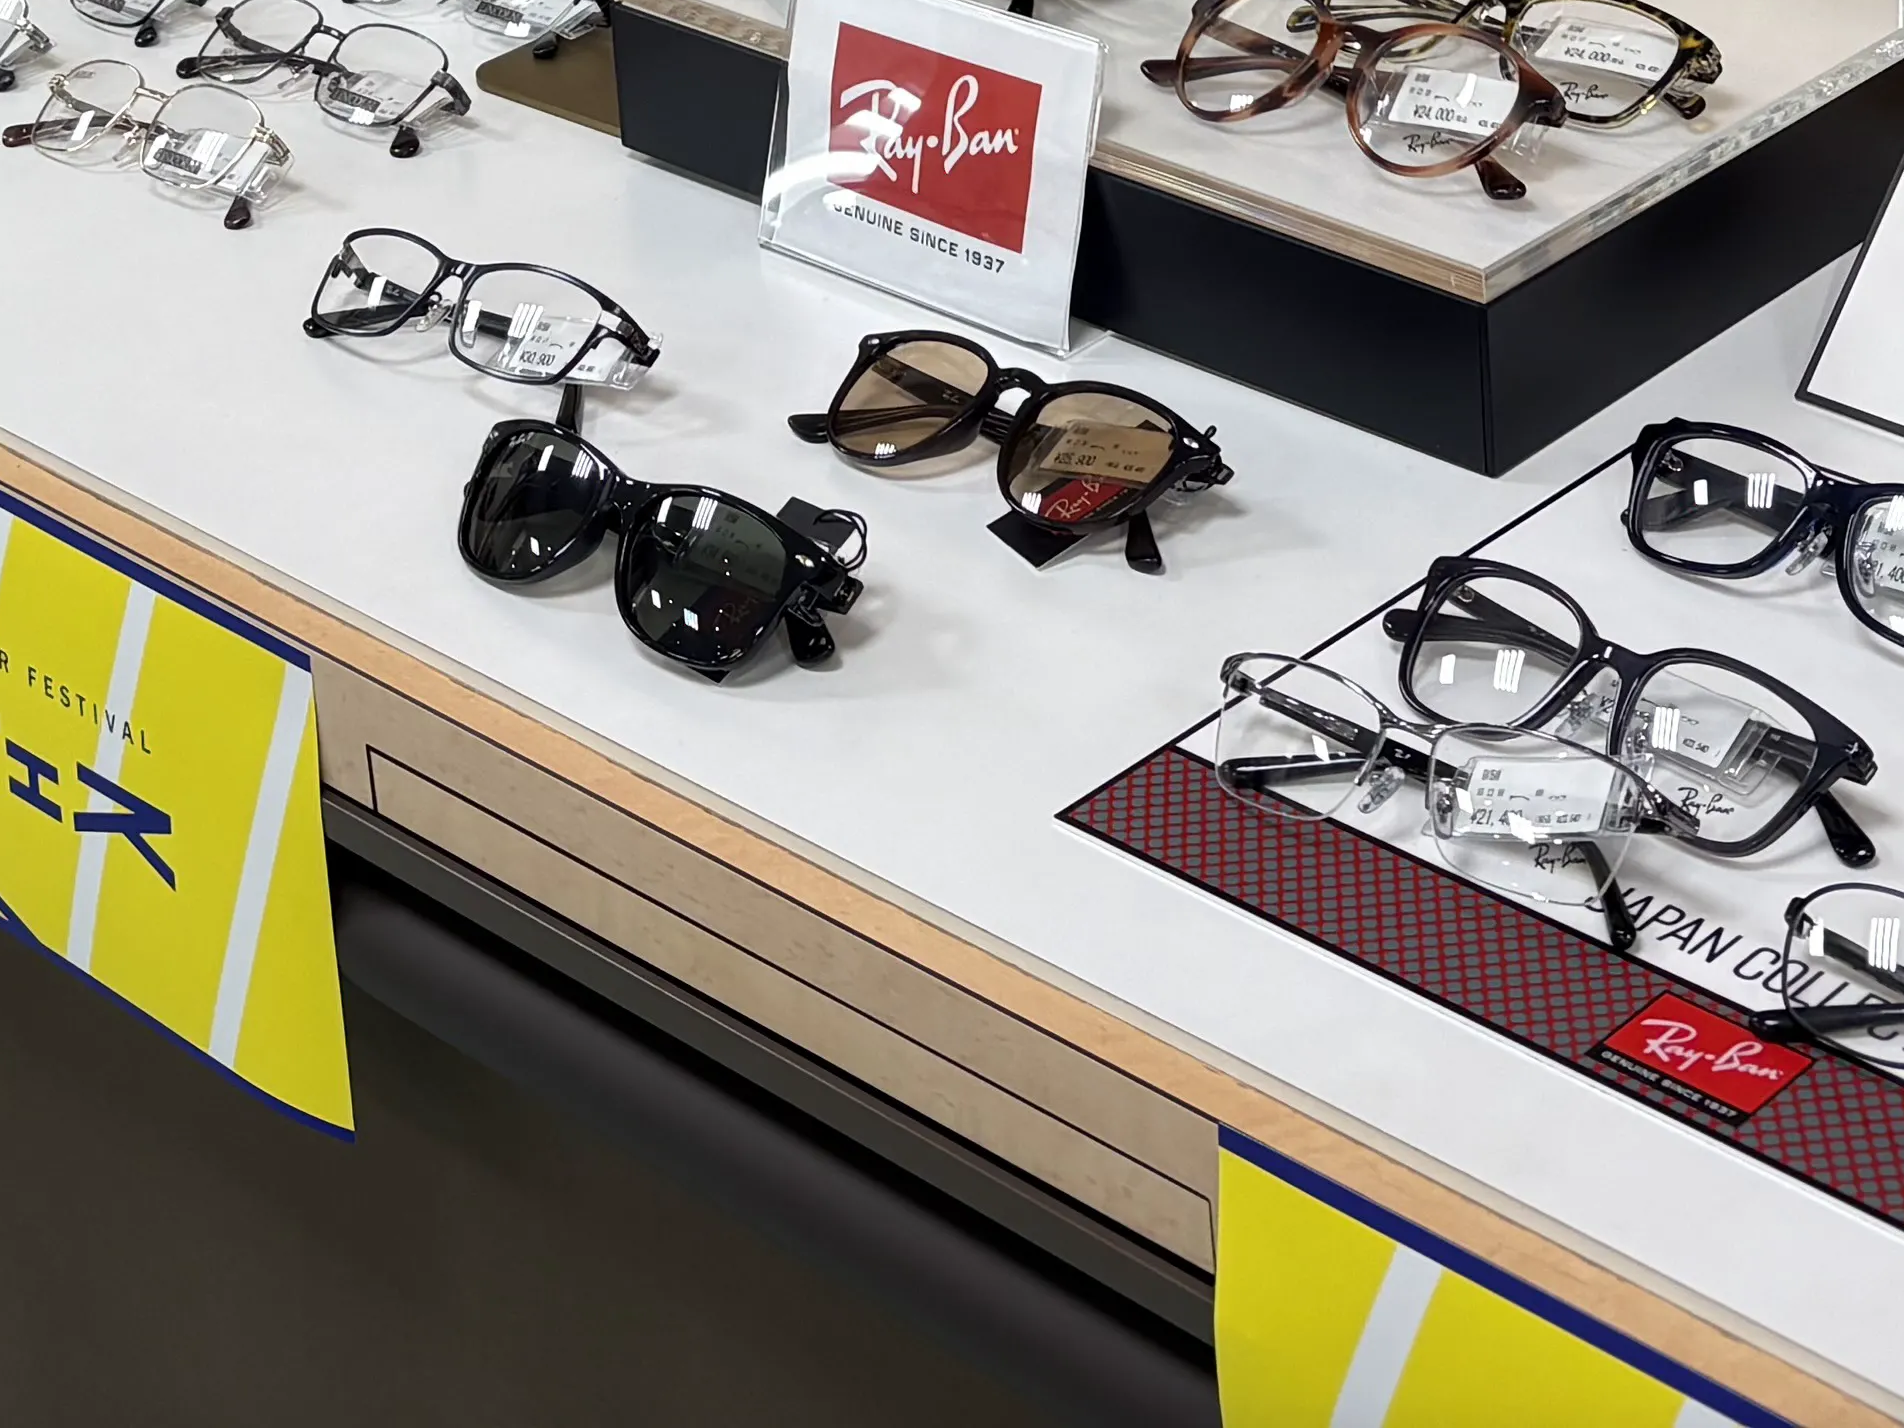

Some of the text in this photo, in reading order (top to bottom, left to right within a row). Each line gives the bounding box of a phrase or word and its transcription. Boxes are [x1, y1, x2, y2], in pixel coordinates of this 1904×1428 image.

[910, 227, 958, 258] SINCE
[965, 248, 1005, 274] 1937
[28, 666, 152, 757] FESTIVAL
[1601, 1051, 1660, 1082] GENUINE
[1661, 1078, 1701, 1103] SINCE
